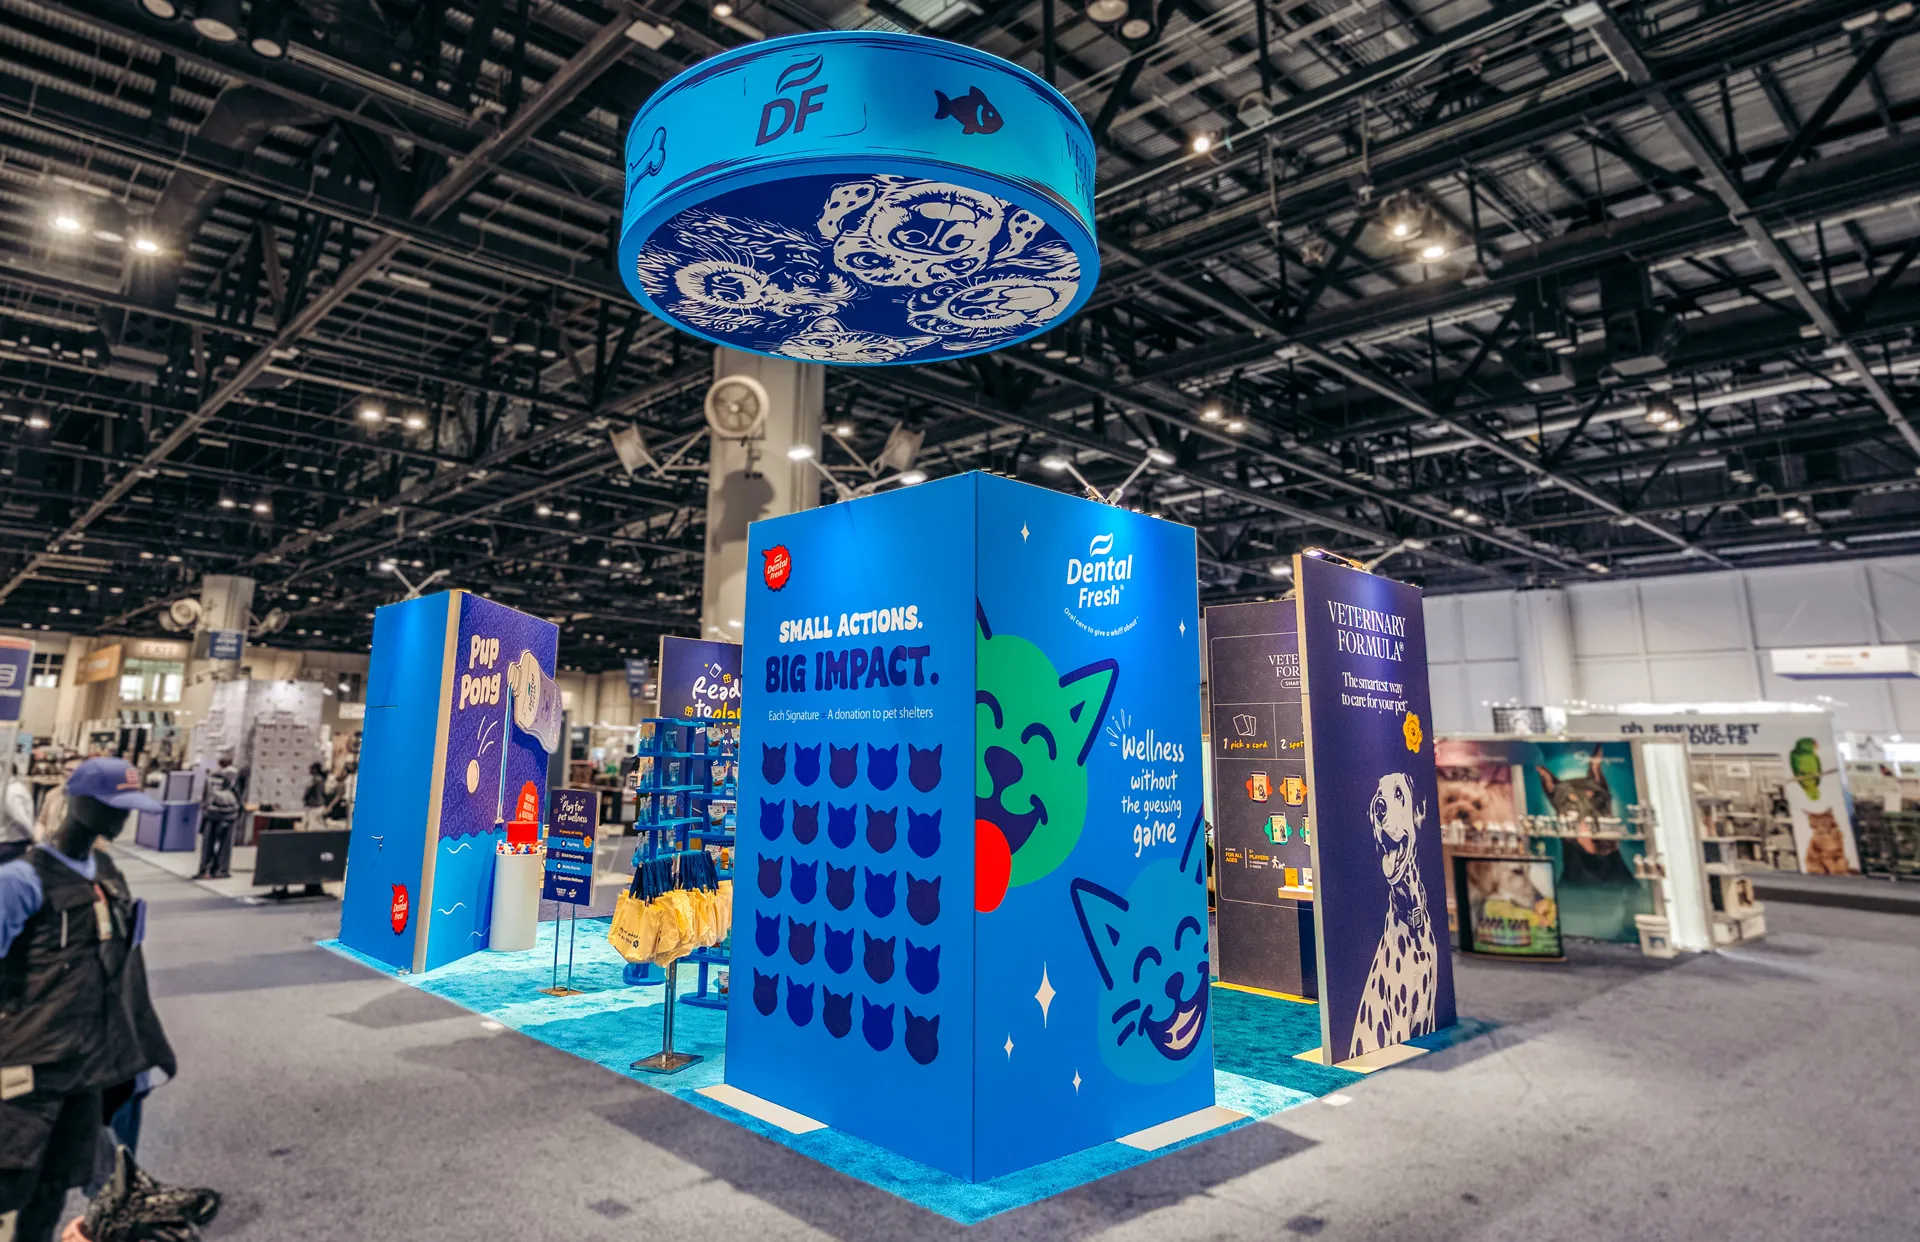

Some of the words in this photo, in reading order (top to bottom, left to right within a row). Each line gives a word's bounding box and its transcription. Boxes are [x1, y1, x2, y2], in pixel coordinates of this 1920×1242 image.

[755, 84, 828, 147] DF
[767, 557, 788, 575] Dental
[1066, 554, 1133, 585] Dental
[779, 615, 833, 643] SMALL
[836, 605, 923, 637] ACTIONS.
[1064, 607, 1076, 622] Oral
[1075, 619, 1087, 631] care
[1088, 626, 1093, 634] to
[1110, 626, 1123, 636] whiff
[1327, 600, 1406, 638] VETERINARY
[469, 634, 499, 669] Pup
[765, 654, 806, 693] BIG
[815, 645, 939, 691] IMPACT.
[459, 672, 501, 710] Pong
[1342, 672, 1358, 688] The
[1358, 677, 1389, 693] smartest
[1388, 681, 1403, 698] way
[694, 698, 712, 718] to
[768, 710, 784, 721] Each
[786, 709, 819, 723] Signature
[827, 709, 833, 719] A
[834, 708, 870, 720] donation
[872, 708, 881, 719] to
[883, 708, 897, 721] pet
[899, 706, 933, 719] shelters
[1342, 693, 1350, 706] to
[1351, 695, 1366, 707] care
[1366, 693, 1377, 709] for
[1377, 698, 1395, 714] your
[1726, 724, 1760, 735] PET
[1122, 729, 1185, 762] Wellness
[1223, 738, 1228, 749] 1
[1230, 740, 1244, 749] pick
[1252, 740, 1268, 748] card
[1280, 739, 1287, 749] 2
[1130, 768, 1178, 791] without
[557, 813, 567, 822] pet
[567, 813, 587, 823] wellness
[562, 800, 574, 814] Play
[575, 801, 584, 812] for
[1121, 796, 1140, 813] the
[1143, 794, 1182, 820] guessing
[1133, 820, 1176, 858] game
